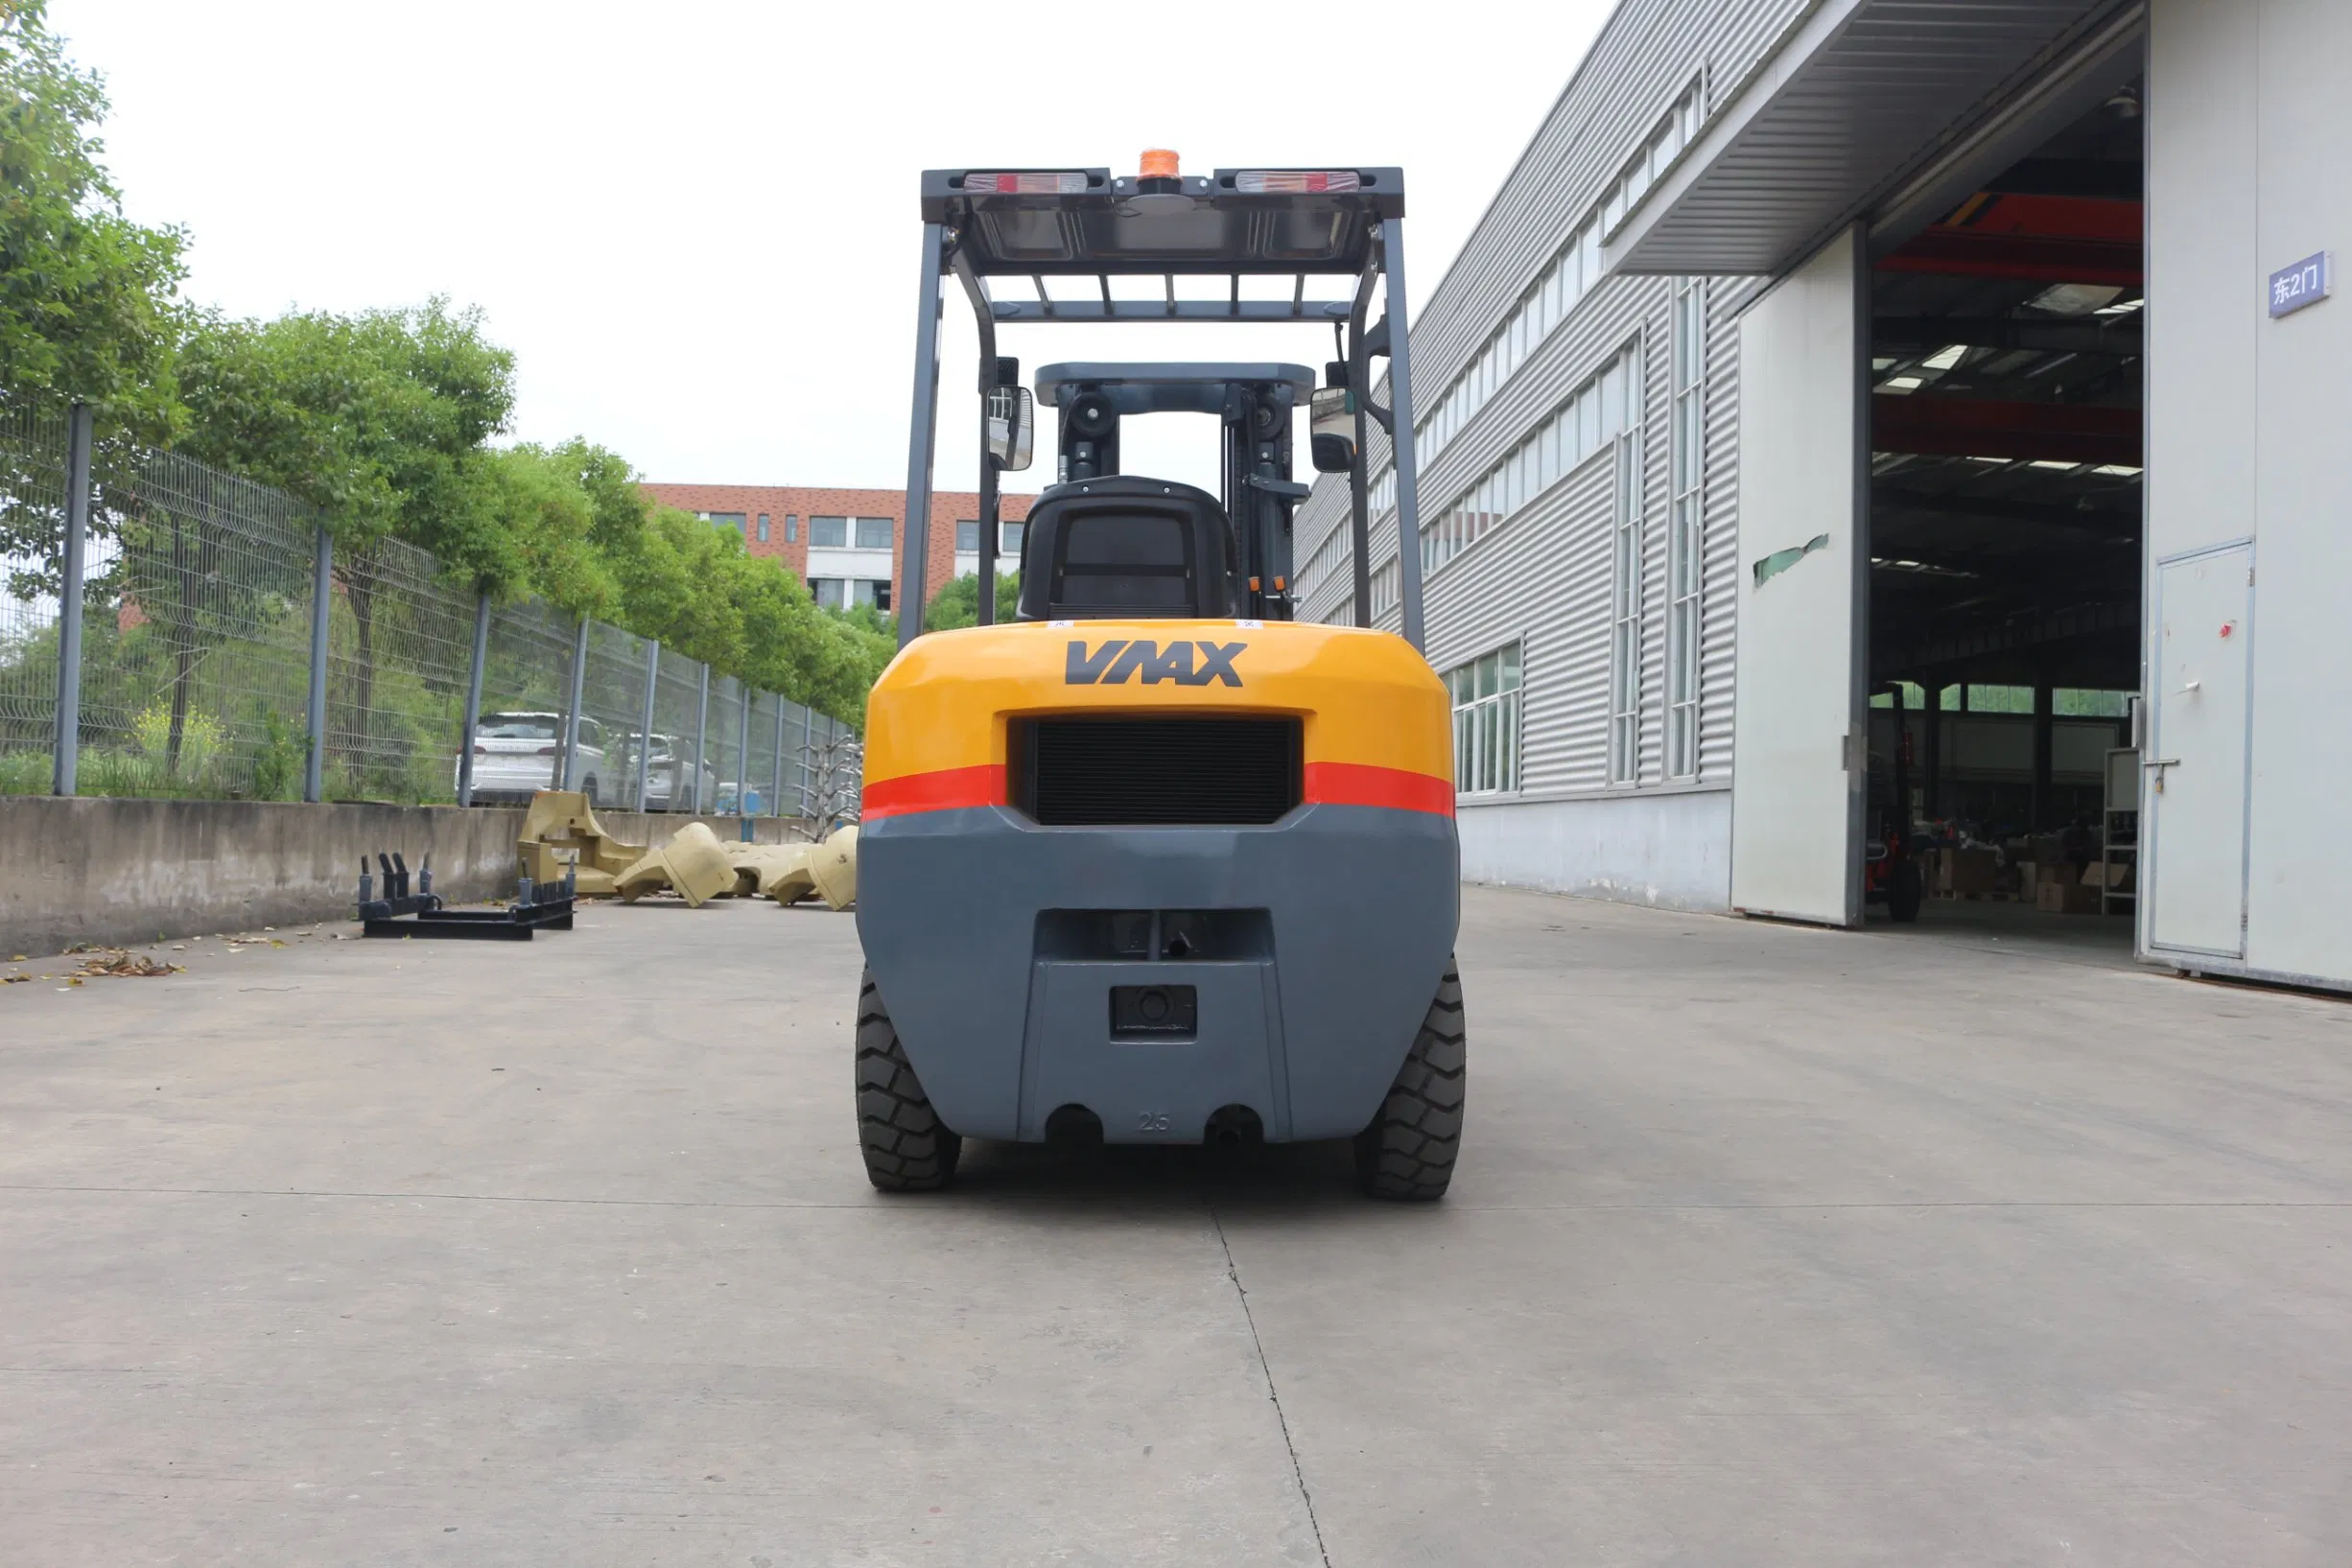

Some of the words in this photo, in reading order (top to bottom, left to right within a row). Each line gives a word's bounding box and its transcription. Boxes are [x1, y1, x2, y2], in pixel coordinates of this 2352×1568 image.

[2273, 264, 2317, 305] 东2门
[1066, 640, 1248, 687] VMAX
[1139, 1112, 1170, 1132] 25
